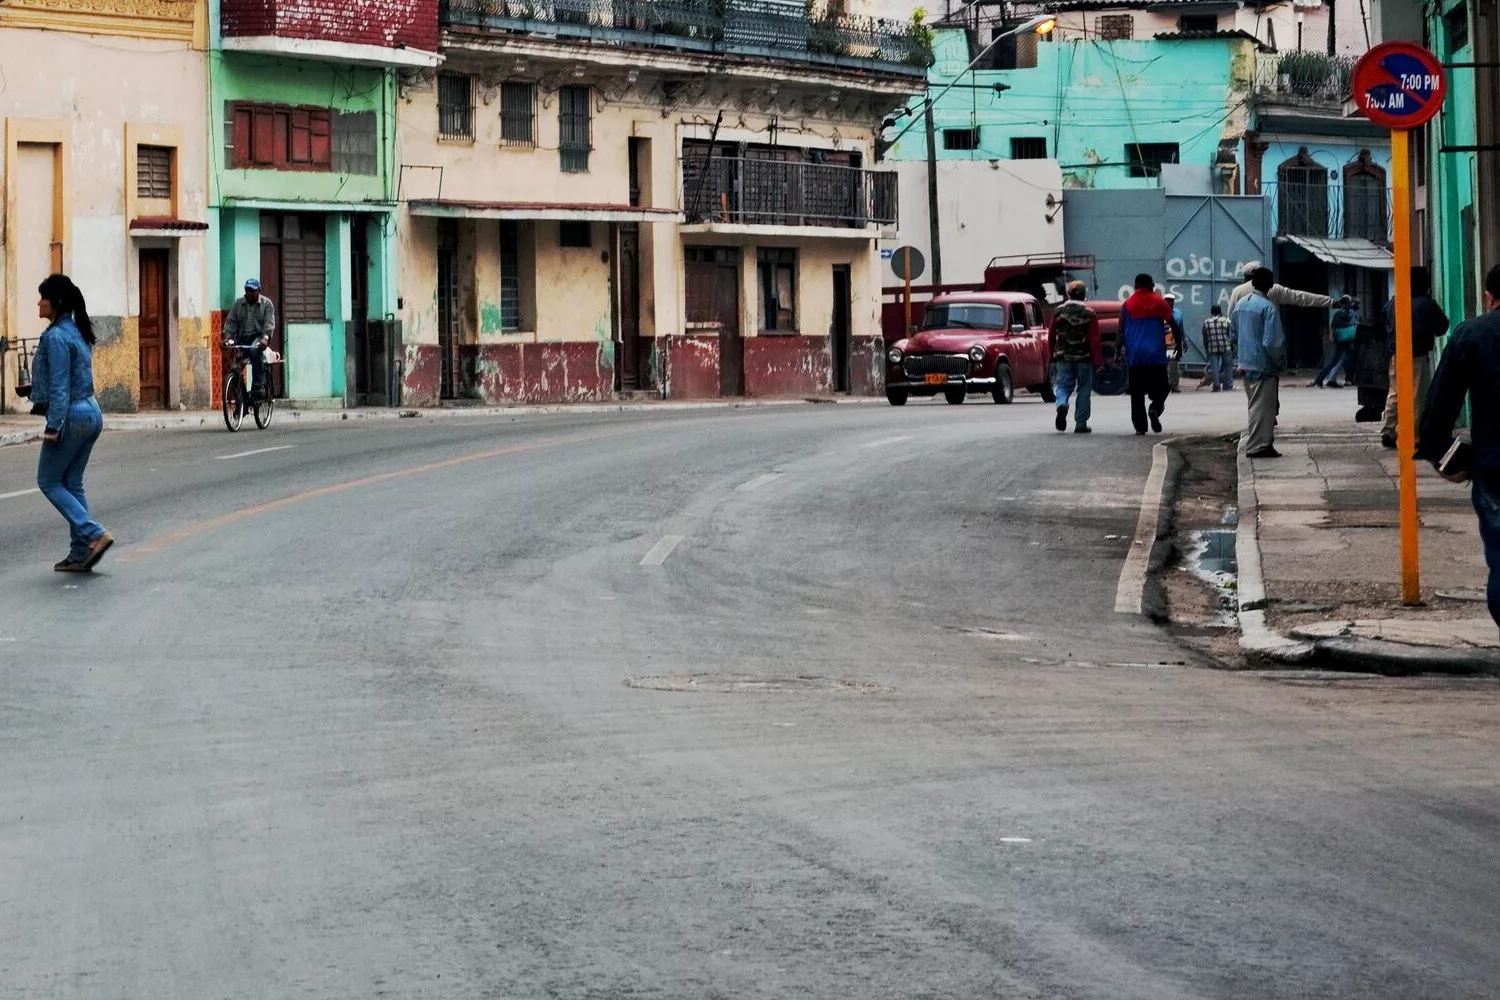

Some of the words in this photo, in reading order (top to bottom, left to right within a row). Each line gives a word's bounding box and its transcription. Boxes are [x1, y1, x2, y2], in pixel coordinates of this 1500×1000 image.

[1400, 73, 1422, 90] 7:00
[1424, 74, 1440, 91] PM
[1388, 93, 1404, 109] AM
